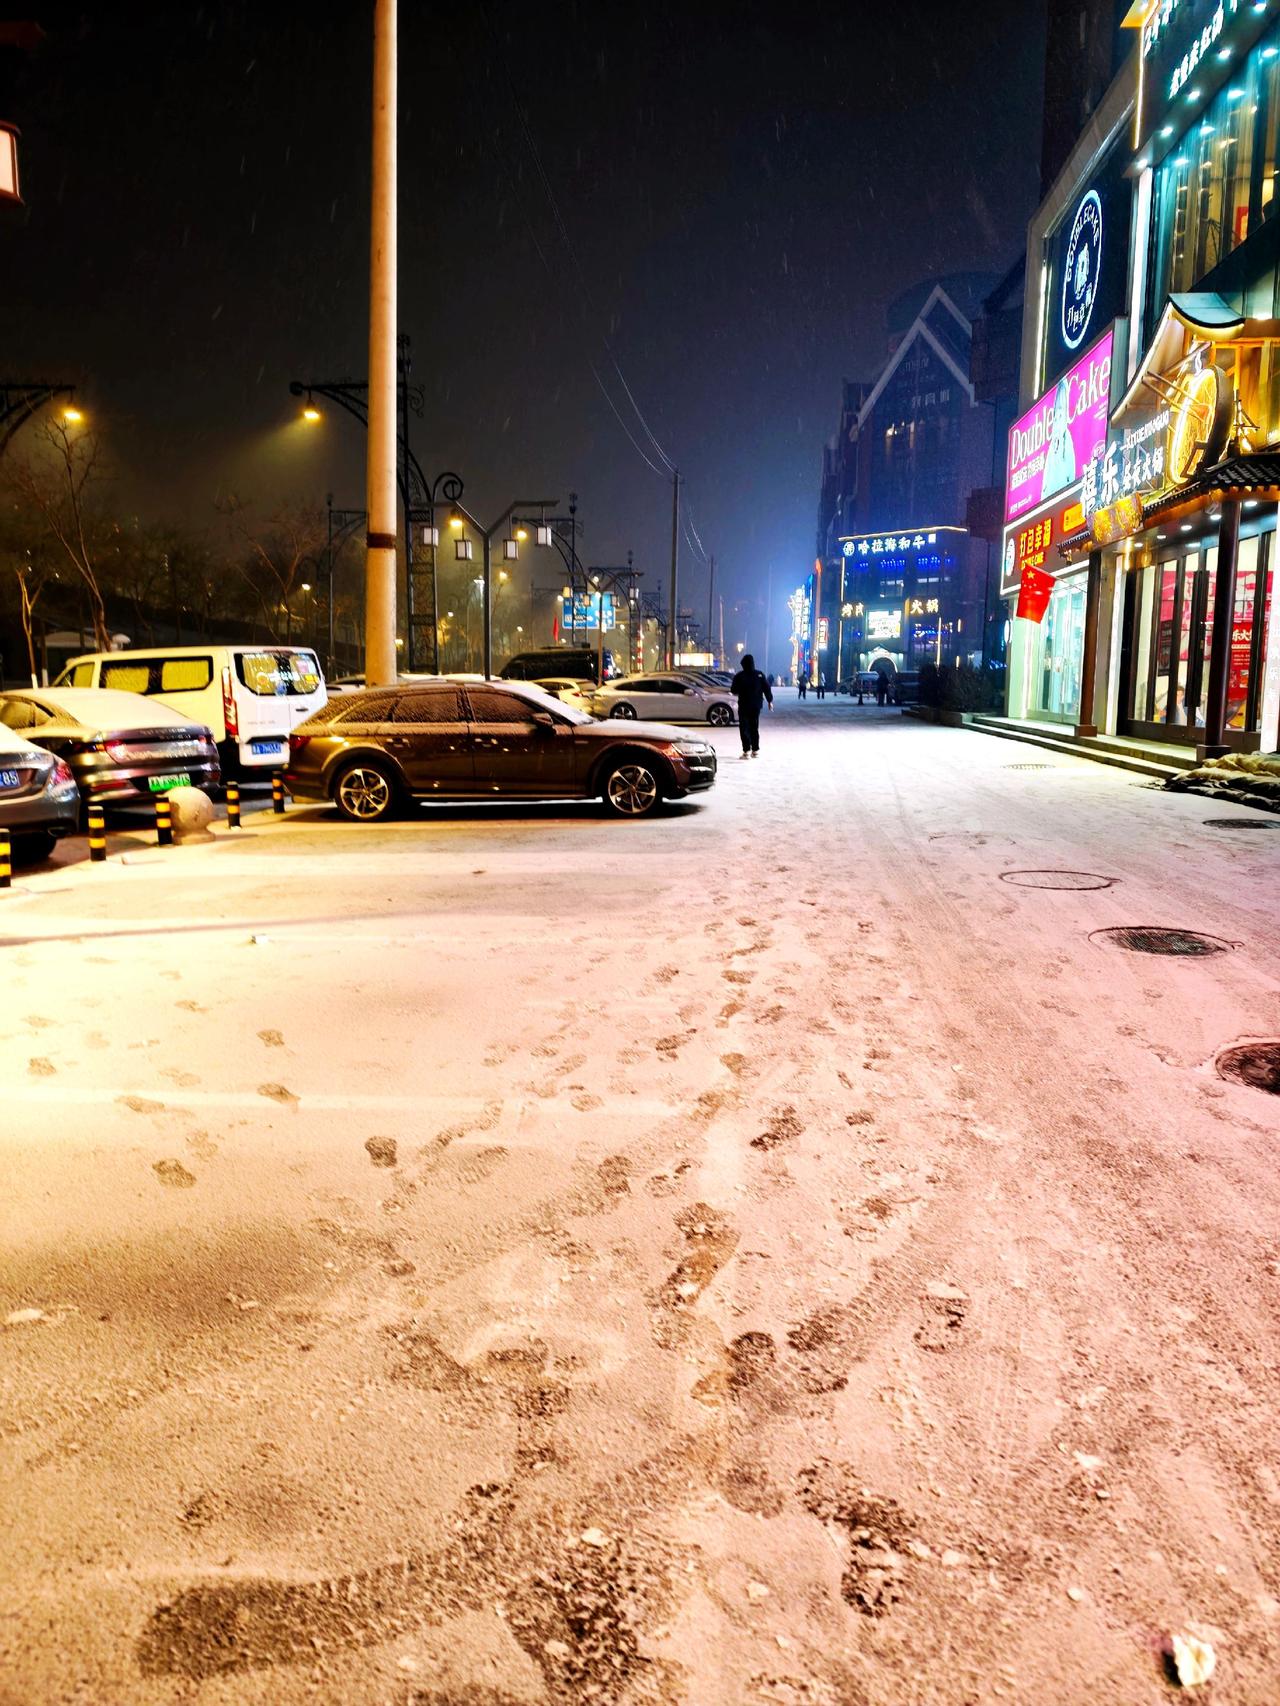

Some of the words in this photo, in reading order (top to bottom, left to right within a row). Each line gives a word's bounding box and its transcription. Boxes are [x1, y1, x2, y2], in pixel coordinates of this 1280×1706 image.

[1010, 407, 1055, 469] Double
[1066, 356, 1111, 425] Cake
[1019, 518, 1052, 558] 打包幸福
[910, 598, 939, 615] 火锅
